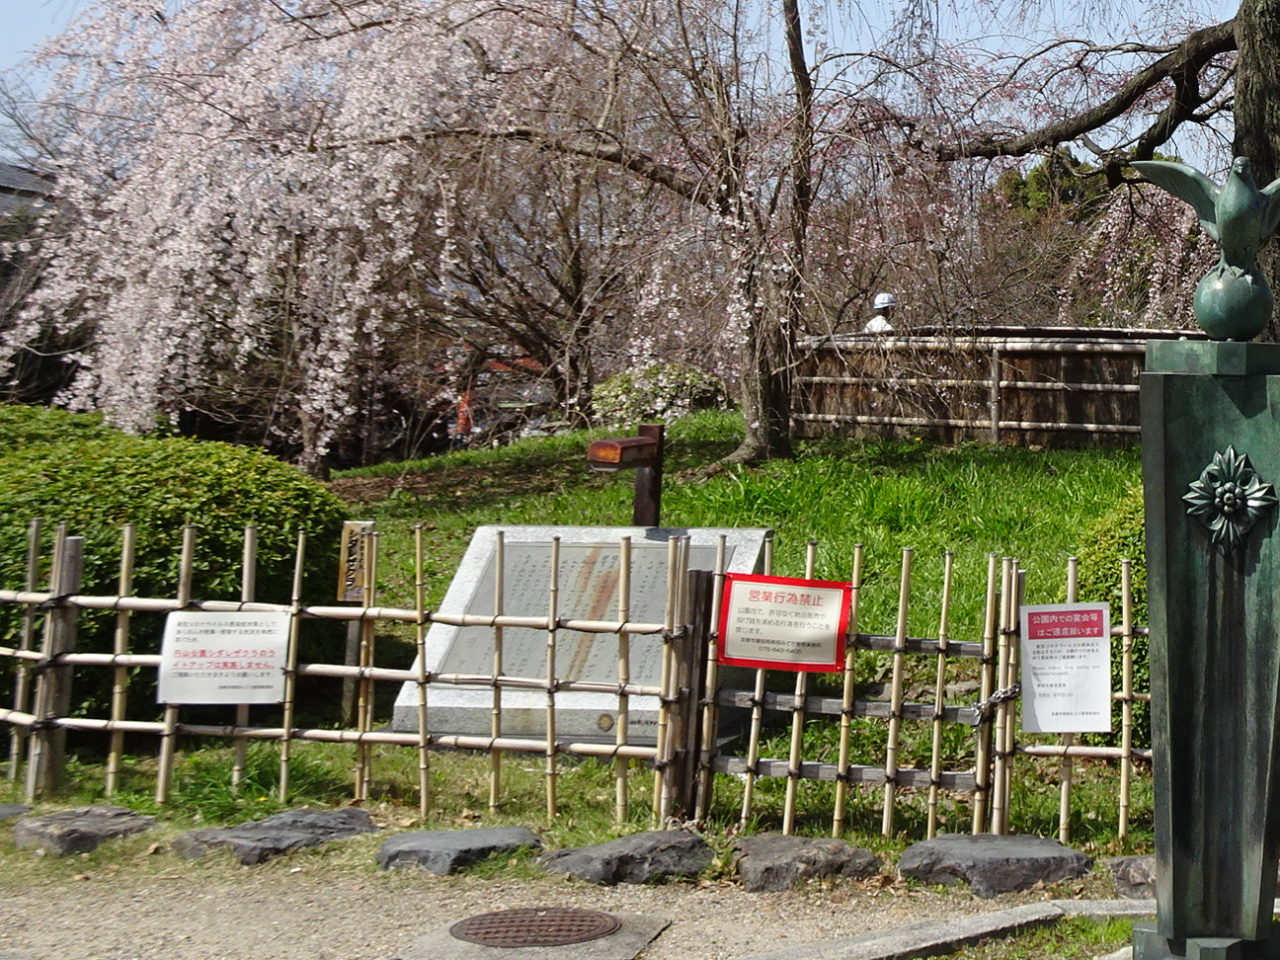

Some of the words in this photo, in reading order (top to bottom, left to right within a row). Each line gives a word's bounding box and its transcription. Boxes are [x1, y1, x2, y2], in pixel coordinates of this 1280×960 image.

[748, 590, 824, 607] 営業行為禁止
[1033, 613, 1098, 624] 公園内での宴会等
[1037, 627, 1100, 637] はご遠慮願います
[174, 649, 275, 657] 円山公園シダレザクラのラ
[173, 661, 275, 669] イトアップは実施しません。
